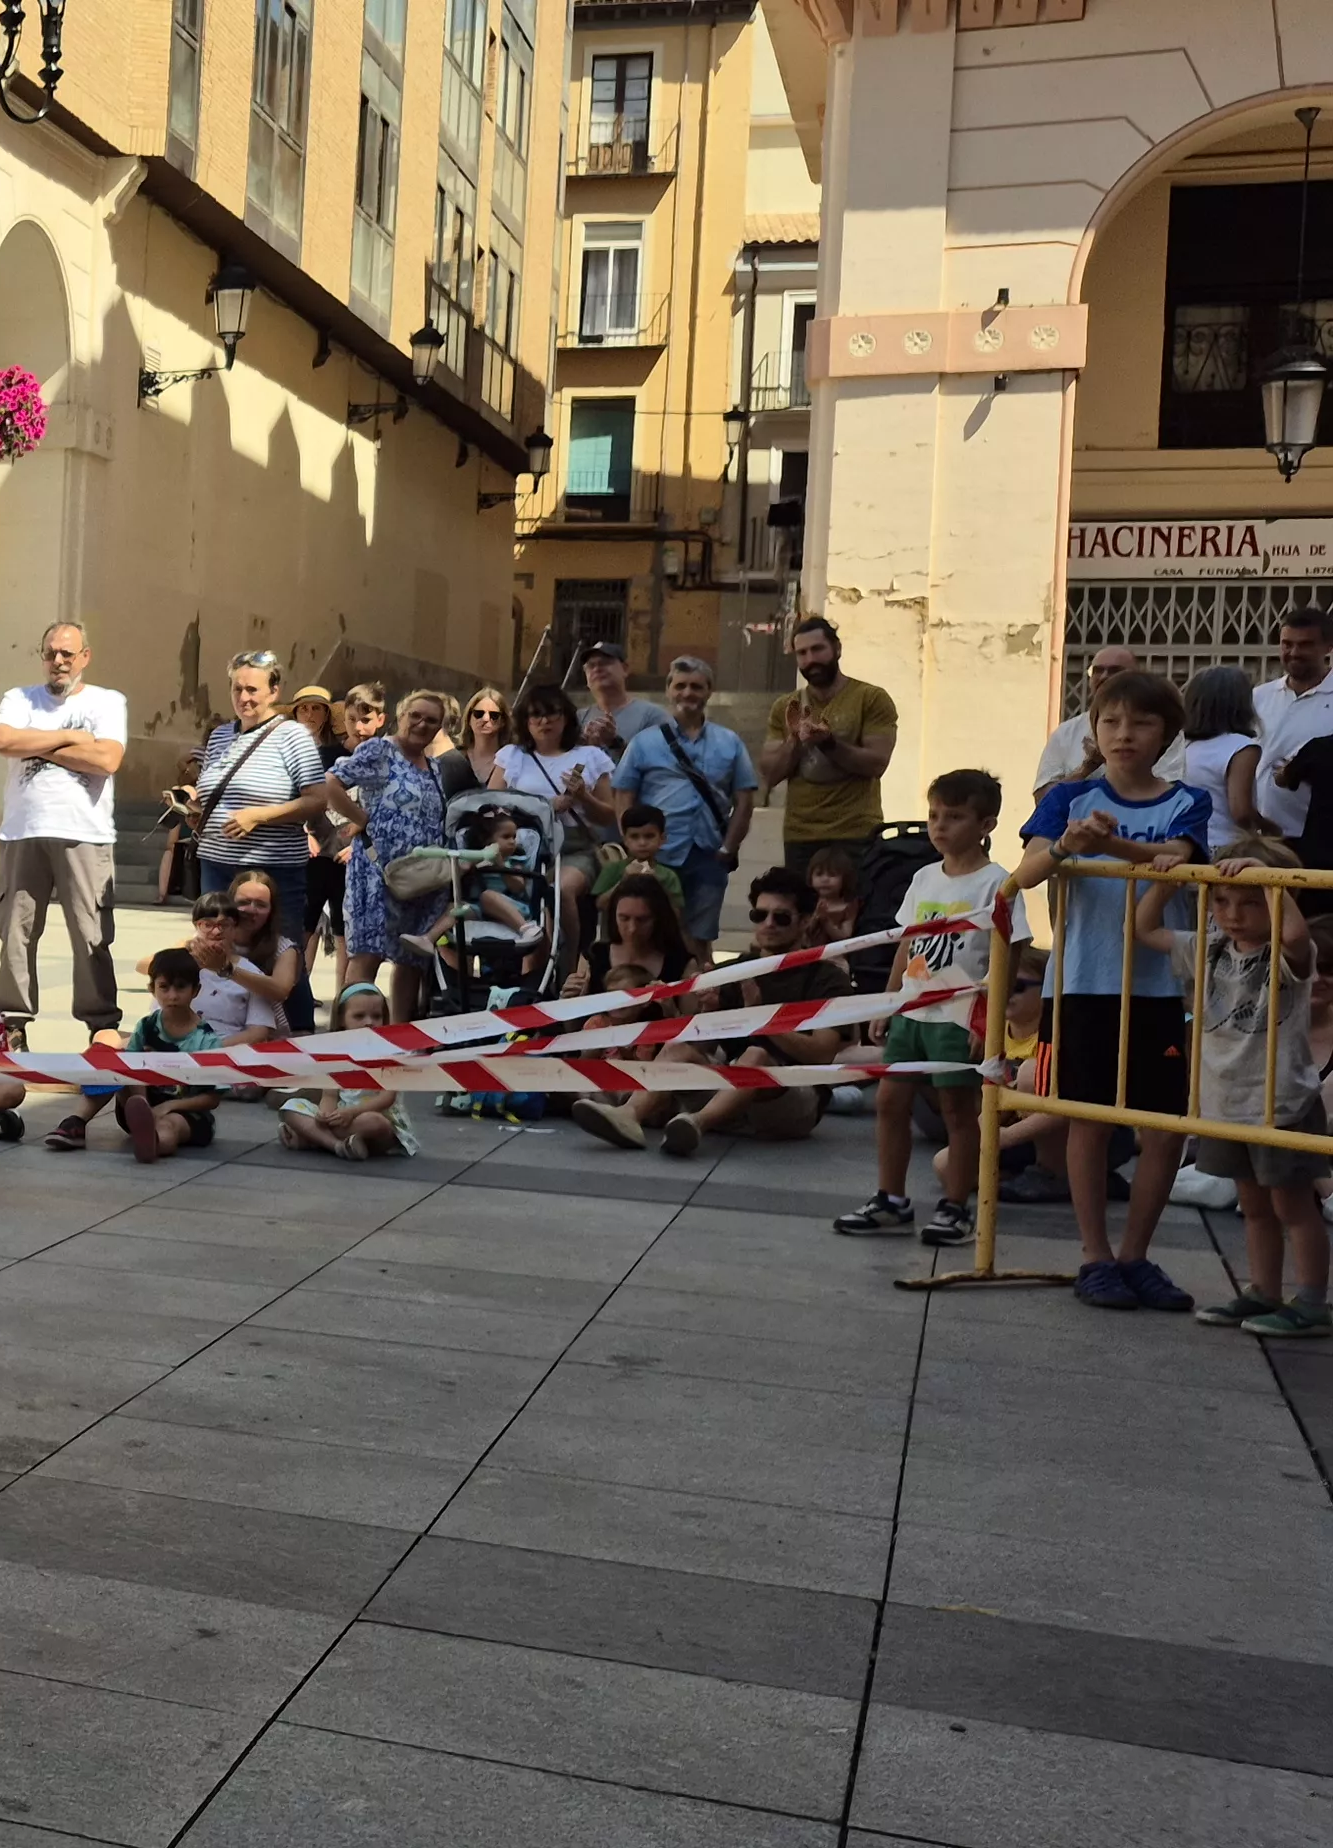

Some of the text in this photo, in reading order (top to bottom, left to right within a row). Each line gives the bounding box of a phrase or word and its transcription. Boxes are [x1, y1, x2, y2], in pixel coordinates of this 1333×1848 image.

[1067, 524, 1327, 558] HACINERIA HIJA DE
[1154, 567, 1184, 576] CASA
